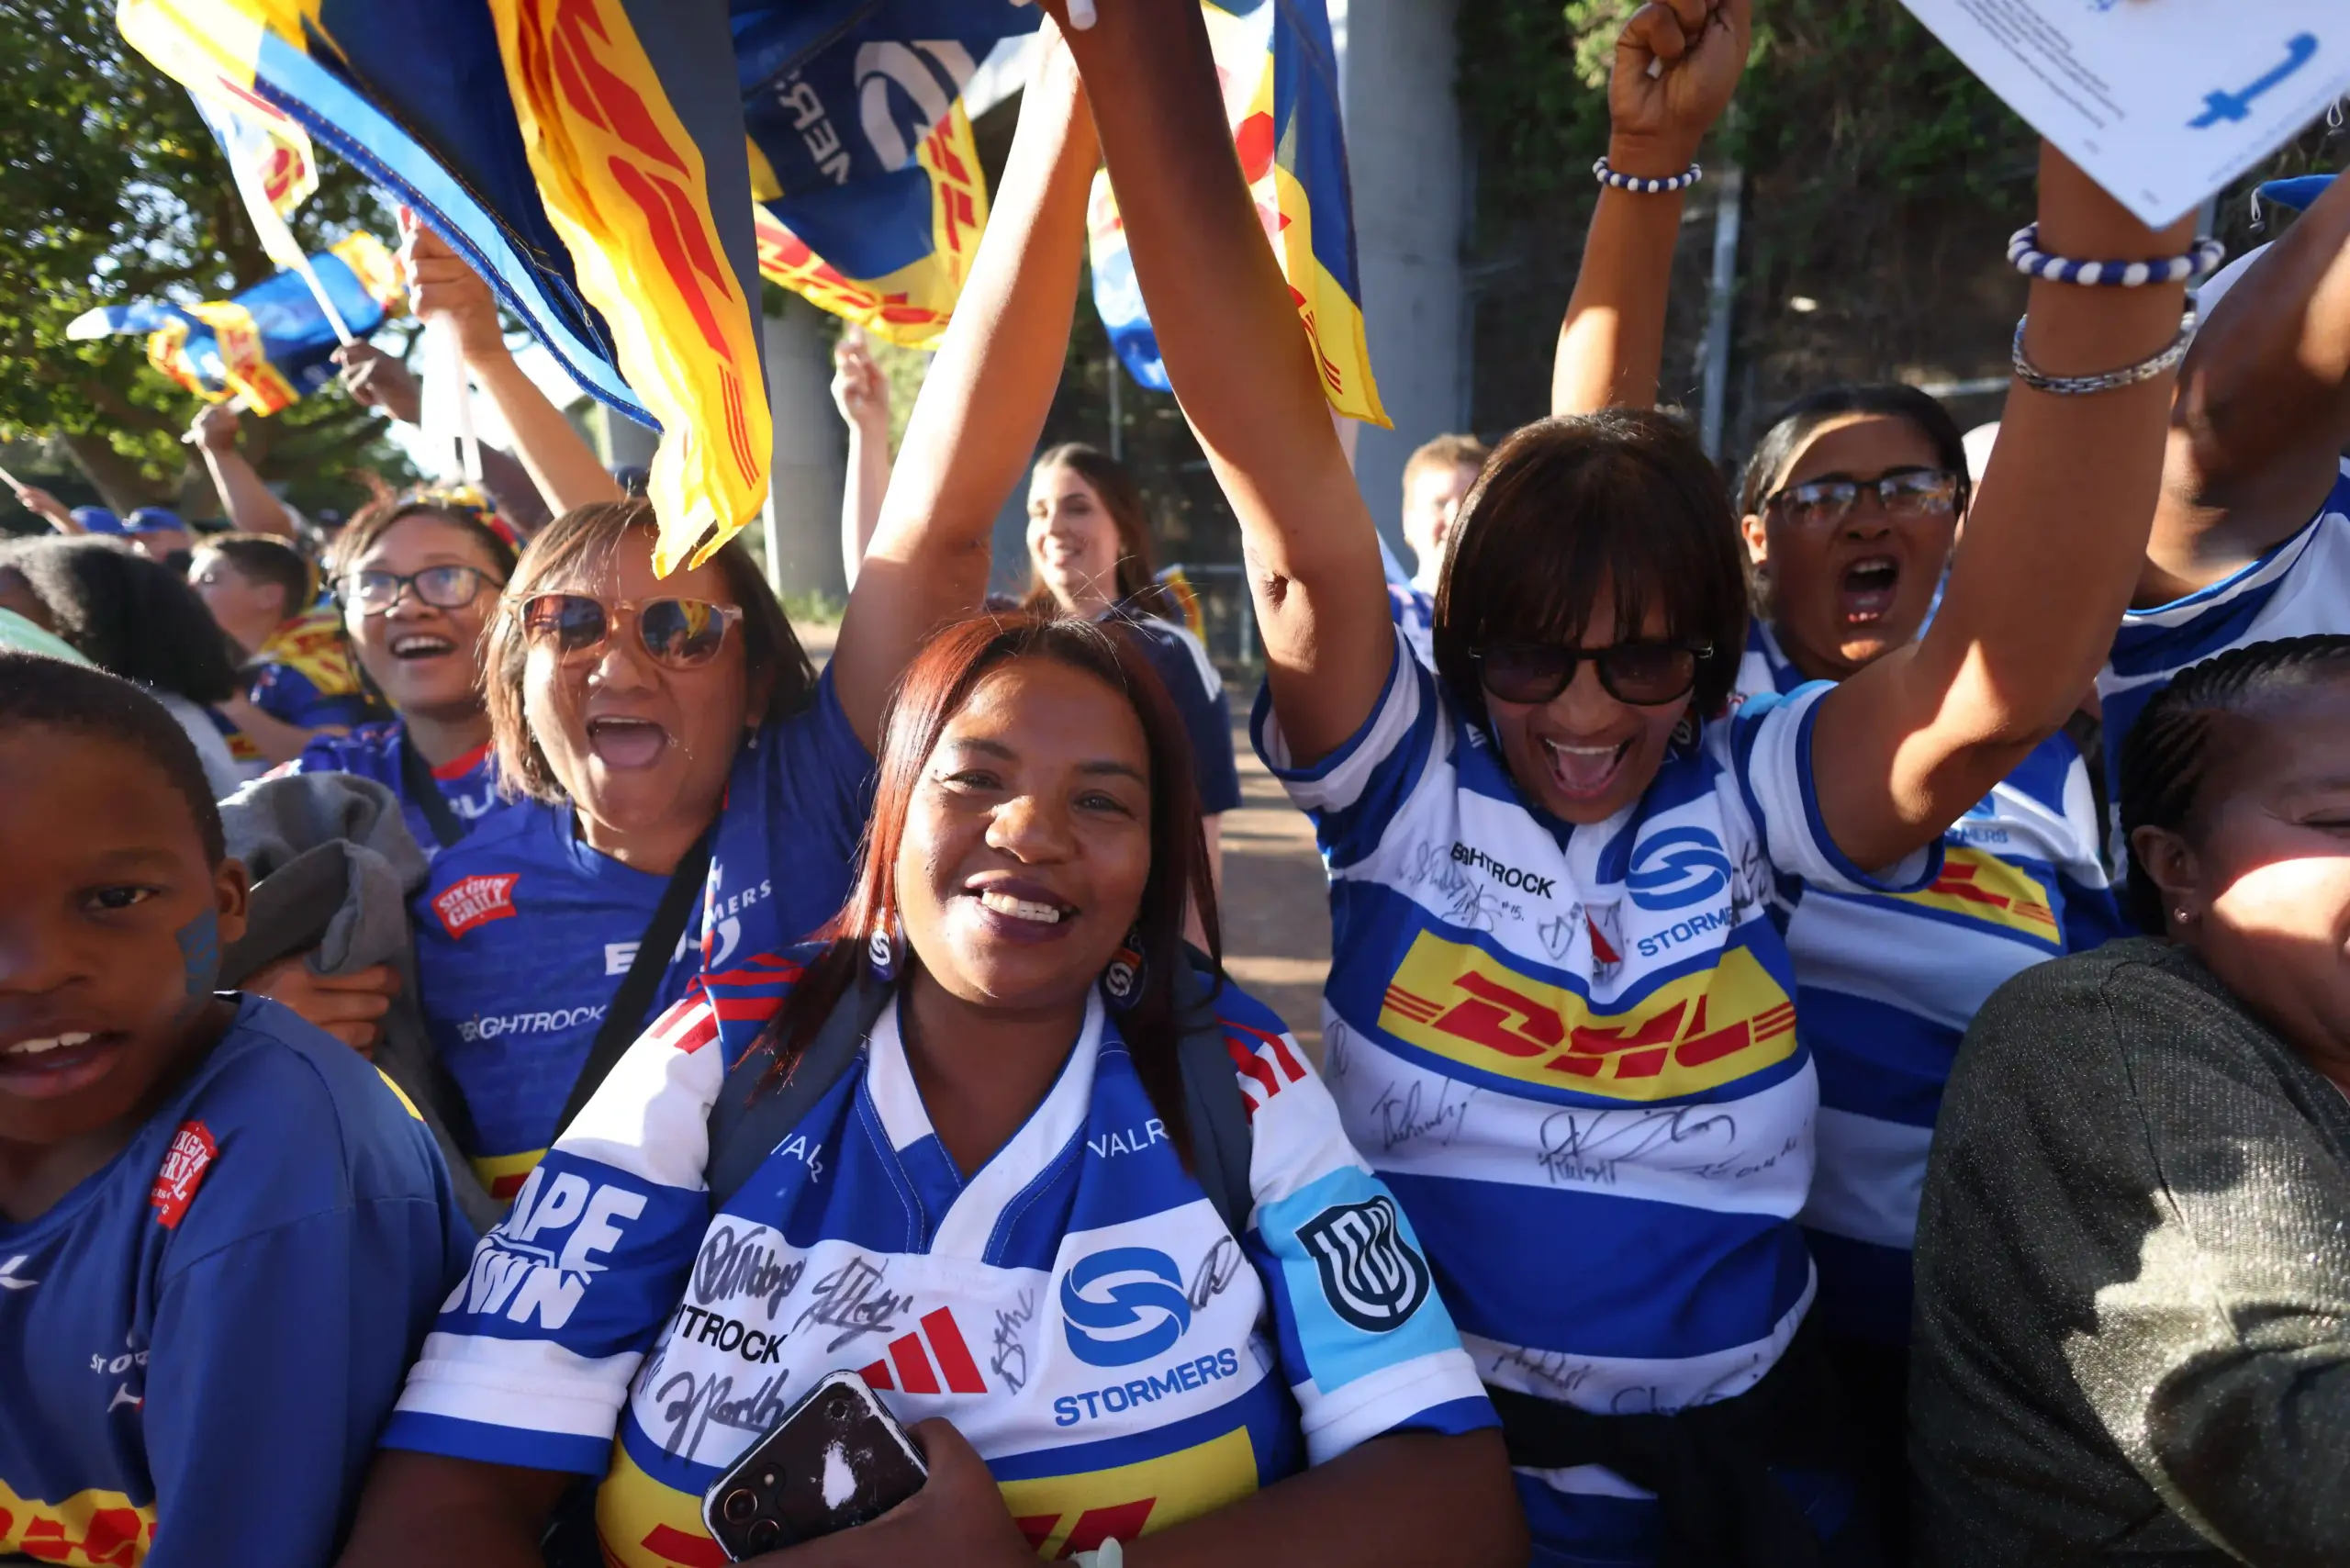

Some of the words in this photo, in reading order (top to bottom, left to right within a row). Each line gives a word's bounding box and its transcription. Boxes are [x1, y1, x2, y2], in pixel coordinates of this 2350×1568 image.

[1432, 970, 1752, 1080] DHL
[1087, 1118, 1169, 1159] VALR
[674, 1304, 789, 1364] TROCK
[1054, 1348, 1238, 1427] STORMERS
